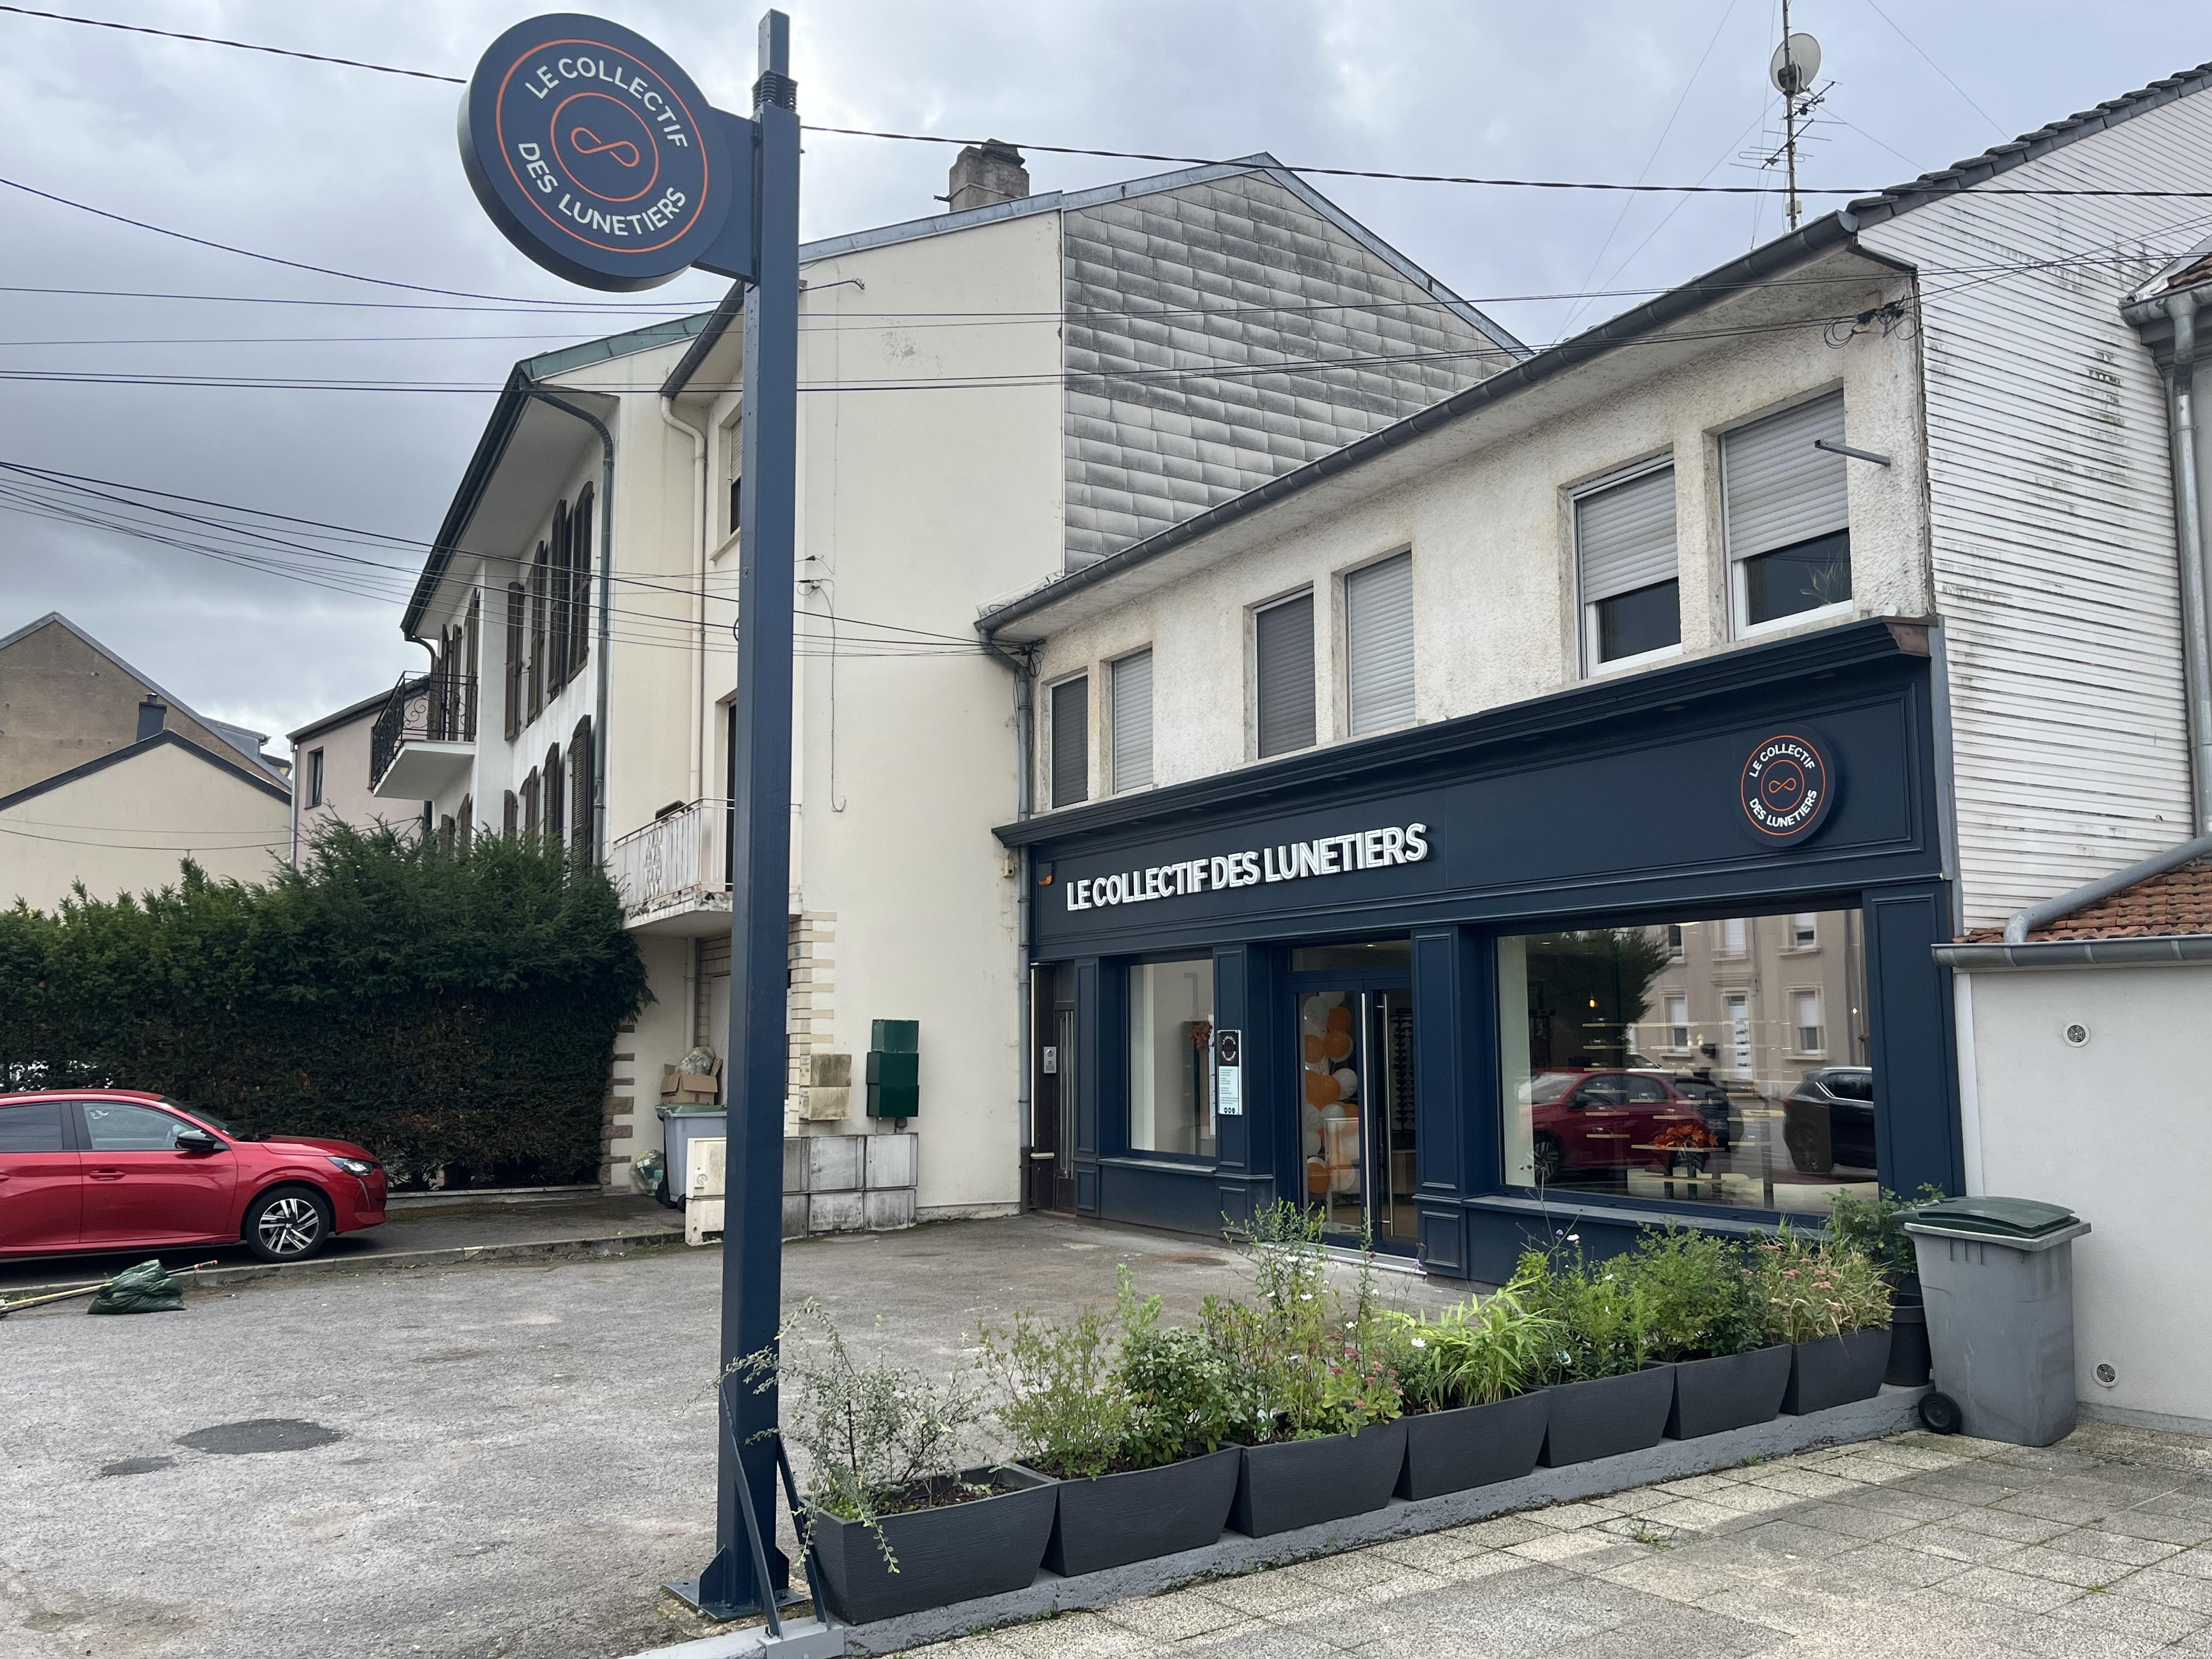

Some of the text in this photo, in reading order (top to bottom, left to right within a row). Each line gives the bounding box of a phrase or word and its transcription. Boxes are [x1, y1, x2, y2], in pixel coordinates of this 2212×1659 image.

[524, 57, 689, 148] LE COLLECTIF
[518, 142, 686, 236] DES LUNETIERS
[1749, 743, 1815, 778] LE COLLECTIF
[1749, 789, 1818, 827] DES LUNETIERS
[1066, 822, 1427, 911] LE COLLECTIF DES LUNETIERS
